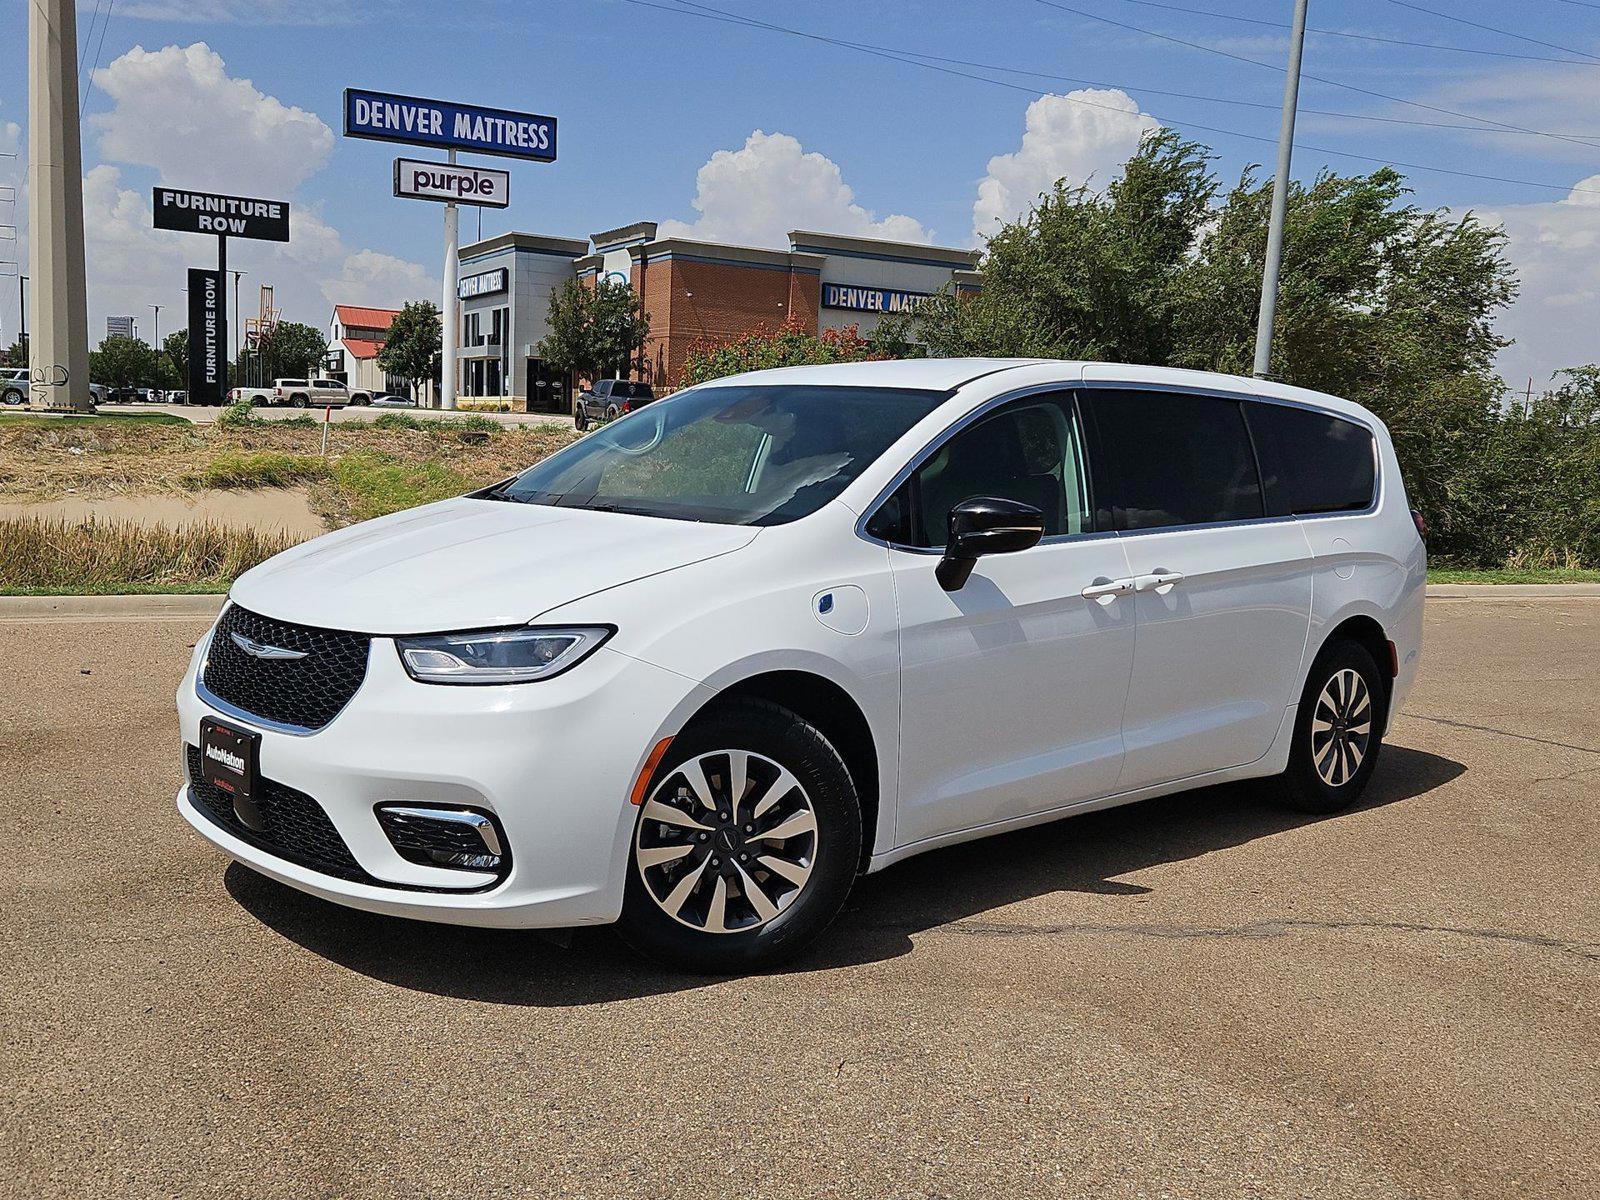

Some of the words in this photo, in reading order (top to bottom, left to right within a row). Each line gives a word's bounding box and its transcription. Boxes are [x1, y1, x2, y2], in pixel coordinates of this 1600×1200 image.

[355, 98, 444, 136] DENVER
[453, 112, 549, 150] MATTRESS
[413, 169, 494, 197] purple
[162, 191, 282, 219] FURNITURE
[198, 214, 248, 234] ROW
[205, 277, 216, 309] ROW
[829, 286, 884, 311] DENVER
[205, 310, 217, 384] FURNITURE
[205, 742, 246, 771] AutoNation
